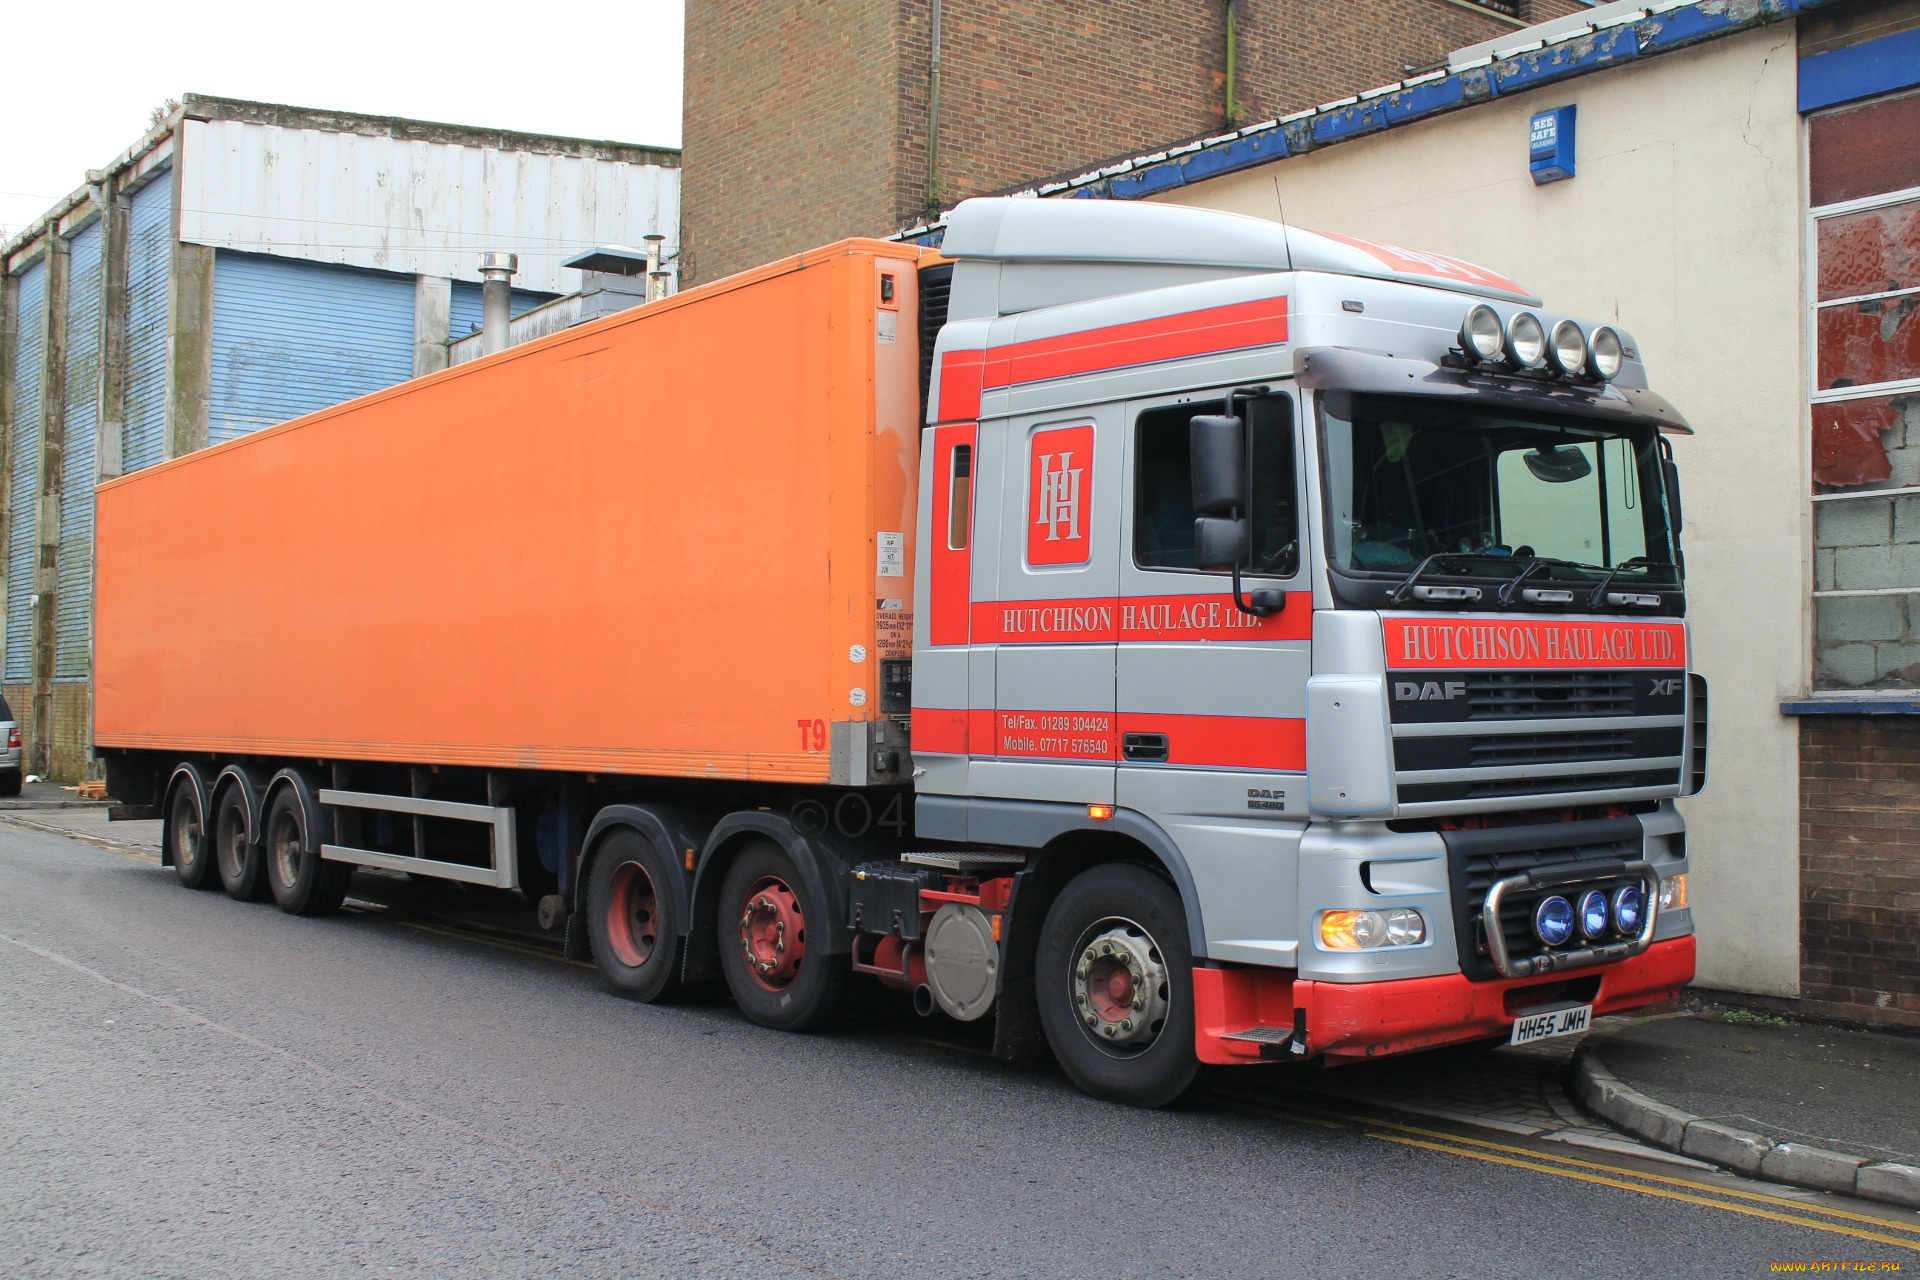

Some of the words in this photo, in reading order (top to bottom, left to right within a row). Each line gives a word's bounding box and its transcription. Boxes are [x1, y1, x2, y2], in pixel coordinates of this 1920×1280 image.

[1533, 118, 1553, 130] BEE
[1531, 127, 1556, 142] SAFE
[1002, 606, 1112, 633] HUTCHISON
[1122, 602, 1222, 630] HAULAGE
[1225, 608, 1262, 628] LTD.
[1401, 625, 1540, 660] HUTCHISON
[1544, 628, 1636, 660] HAULAGE
[1640, 629, 1677, 660] LTD.
[1394, 681, 1466, 701] DAF
[1648, 679, 1682, 696] XF
[1002, 714, 1038, 730] Tel/Fax.
[1041, 716, 1070, 731] 01289
[1072, 717, 1109, 732] 304424
[798, 718, 826, 751] T9
[1003, 736, 1037, 751] Mobile.
[1040, 738, 1068, 752] 07717
[1072, 739, 1108, 754] 576540
[1248, 788, 1285, 799] DAF
[1517, 1015, 1556, 1041] HH55
[1558, 1010, 1587, 1032] JMH
